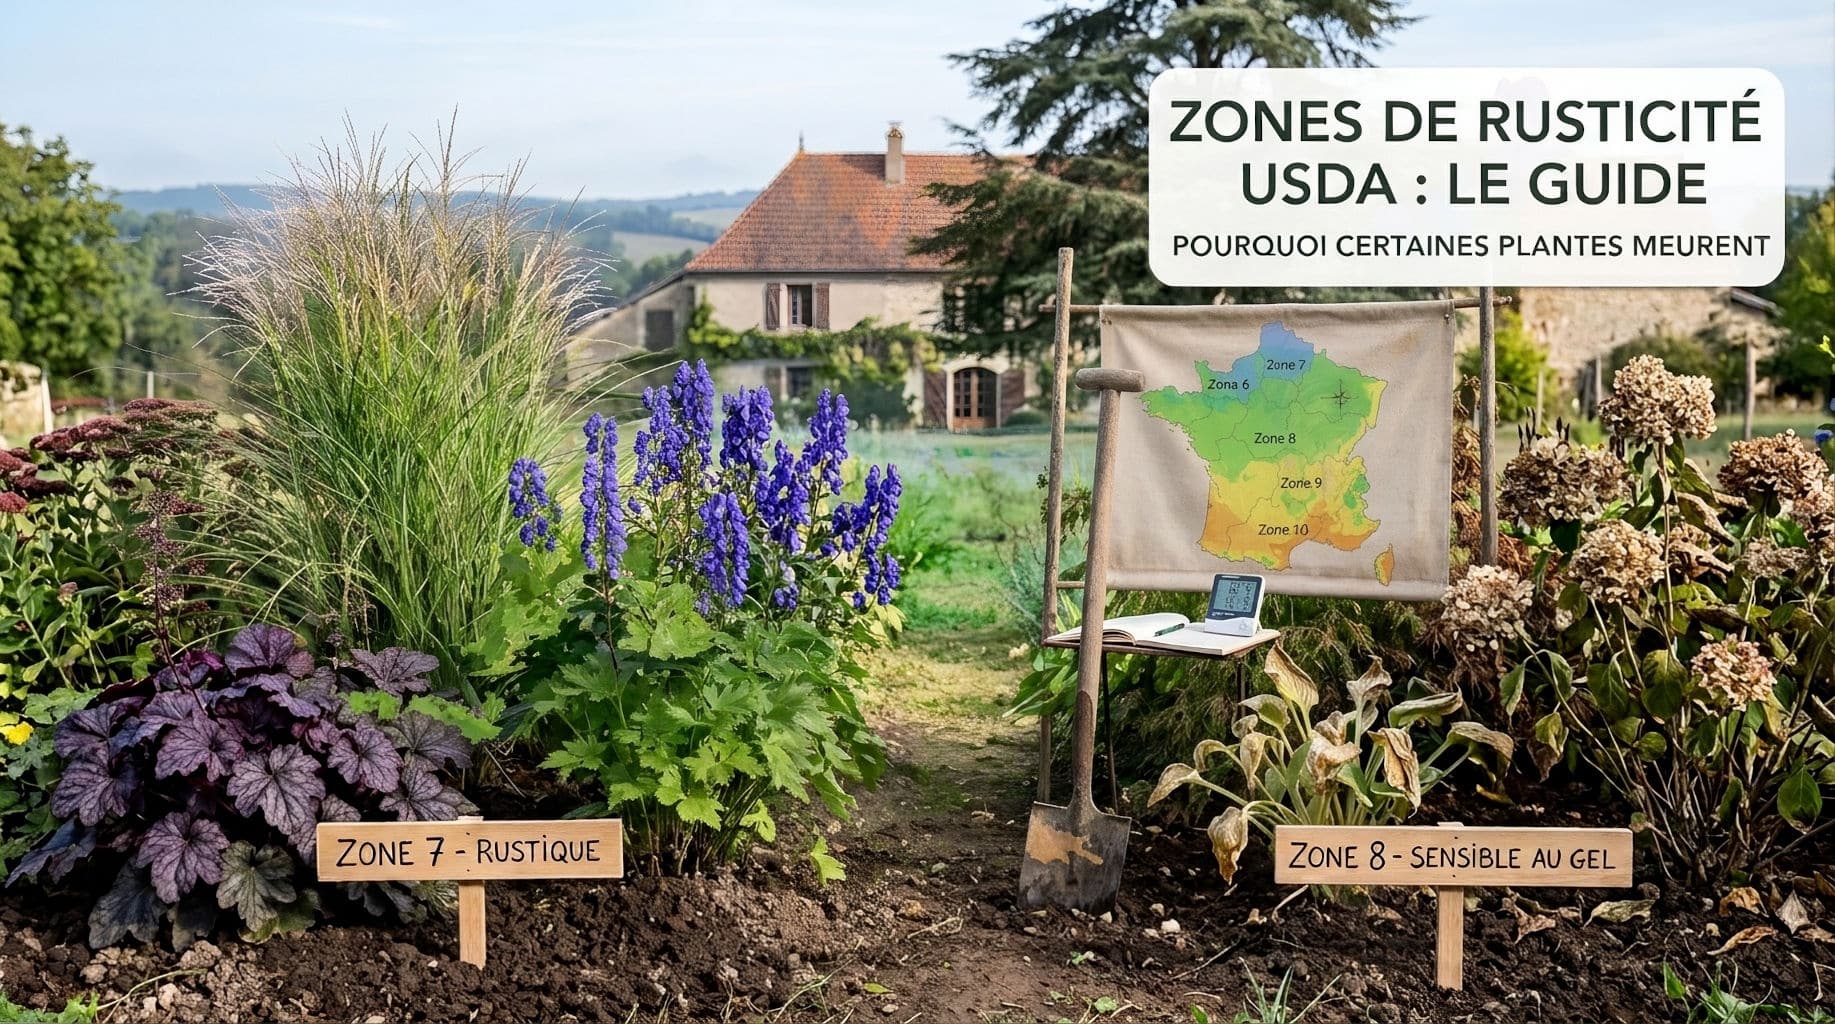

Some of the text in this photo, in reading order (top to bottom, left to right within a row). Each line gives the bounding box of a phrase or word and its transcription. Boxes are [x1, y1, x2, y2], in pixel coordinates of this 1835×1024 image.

[1298, 359, 1306, 371] 7
[1207, 379, 1250, 390] Zona 6
[1254, 432, 1297, 444] Zone 8
[1314, 477, 1323, 489] 9
[1258, 523, 1309, 536] Zone 10
[335, 838, 415, 868] ZONE
[426, 836, 445, 868] 7
[1288, 841, 1359, 869] ZONE
[1369, 840, 1386, 871] 8
[1531, 847, 1562, 869] AU
[1569, 848, 1618, 870] GEL
